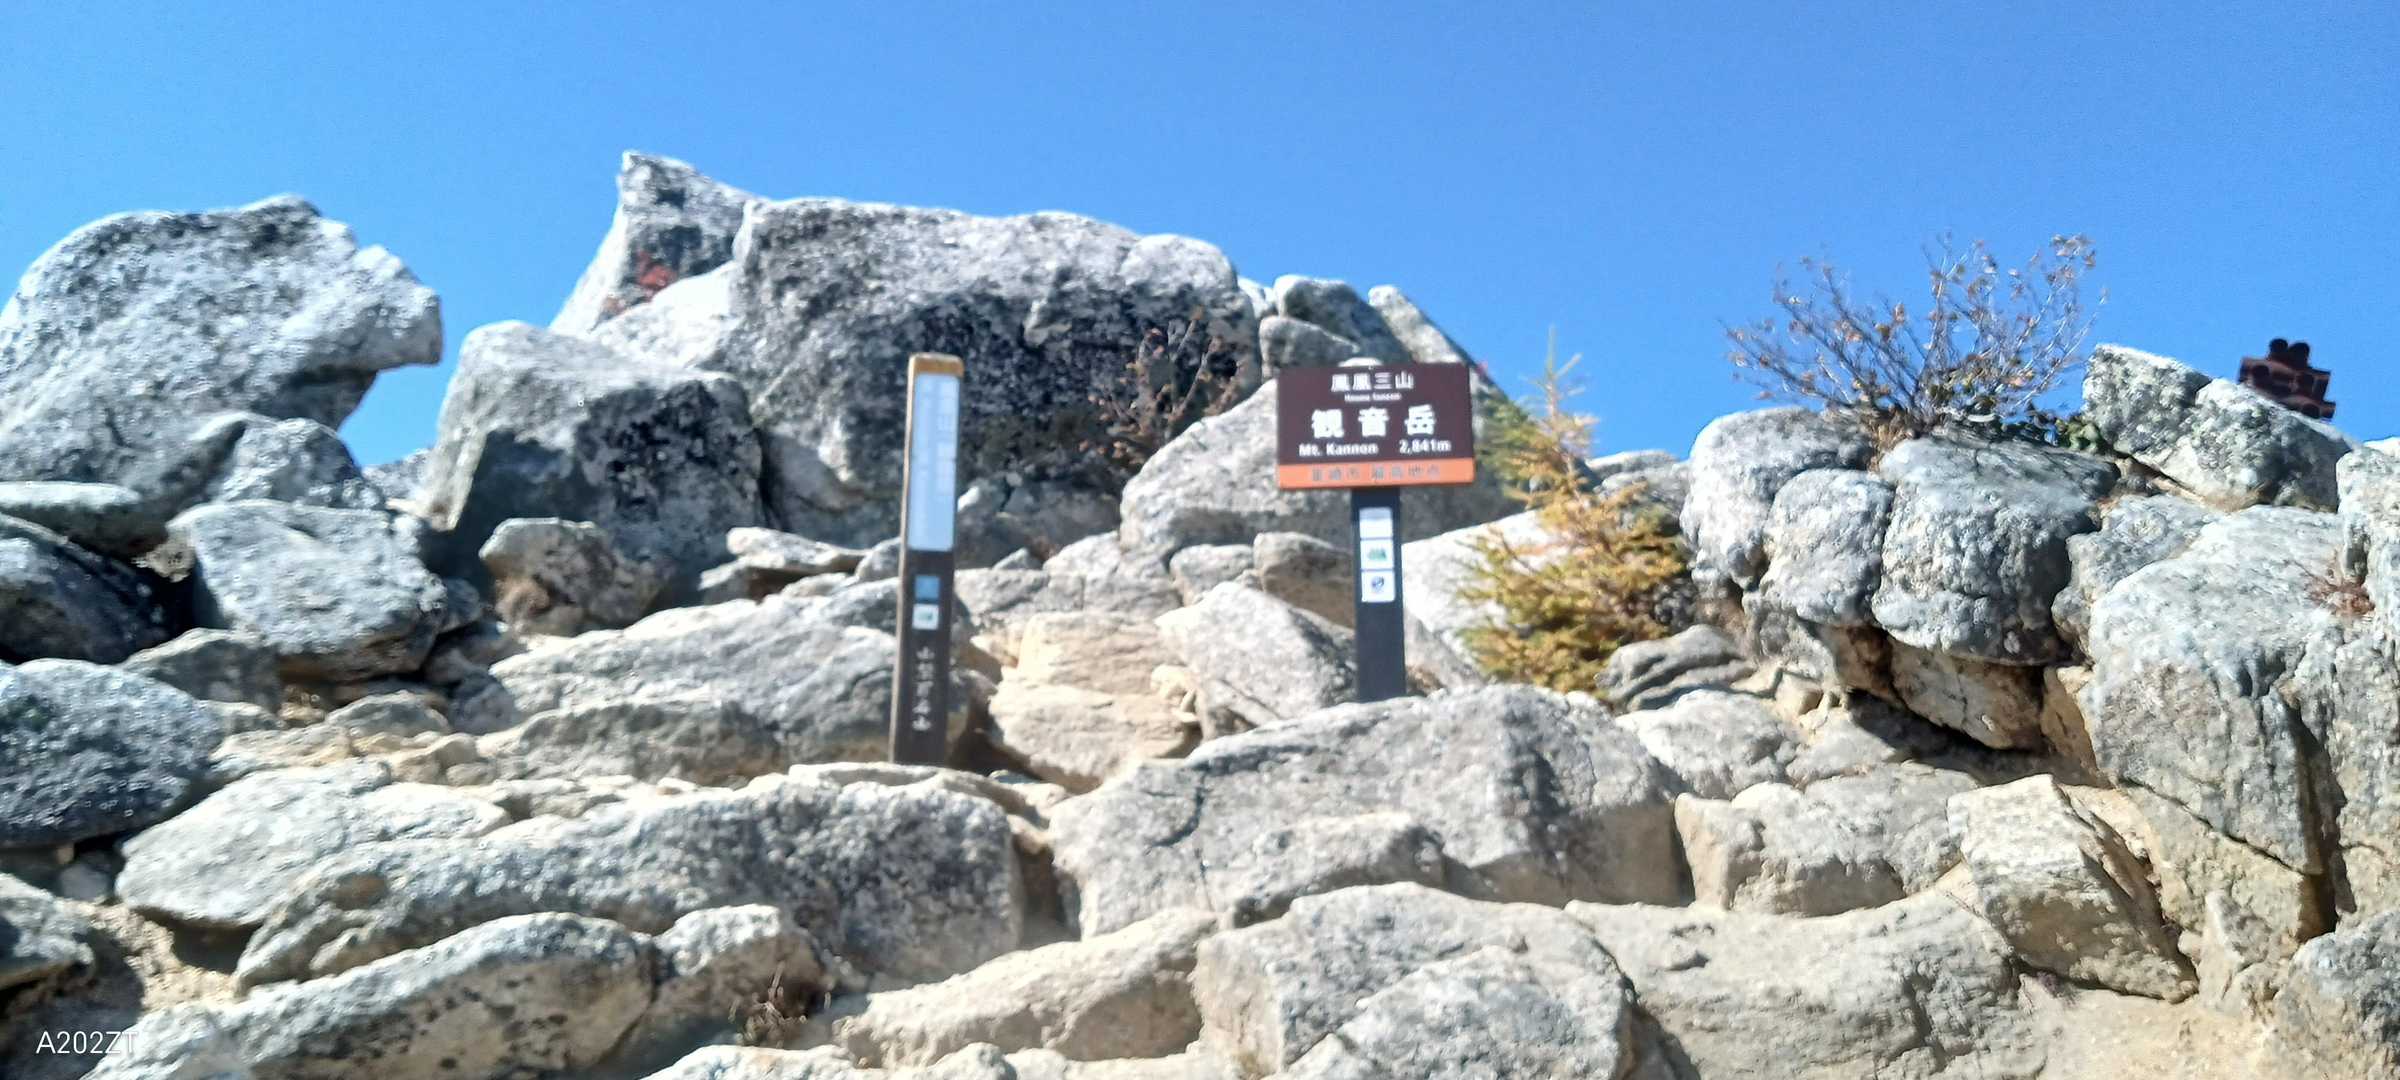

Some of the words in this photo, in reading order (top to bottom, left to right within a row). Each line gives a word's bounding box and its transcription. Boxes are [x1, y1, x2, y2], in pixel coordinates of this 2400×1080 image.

[1311, 404, 1437, 439] 観音岳
[1299, 443, 1320, 457] Mt.
[1326, 442, 1378, 456] Kannon
[1399, 439, 1452, 455] 2,841m
